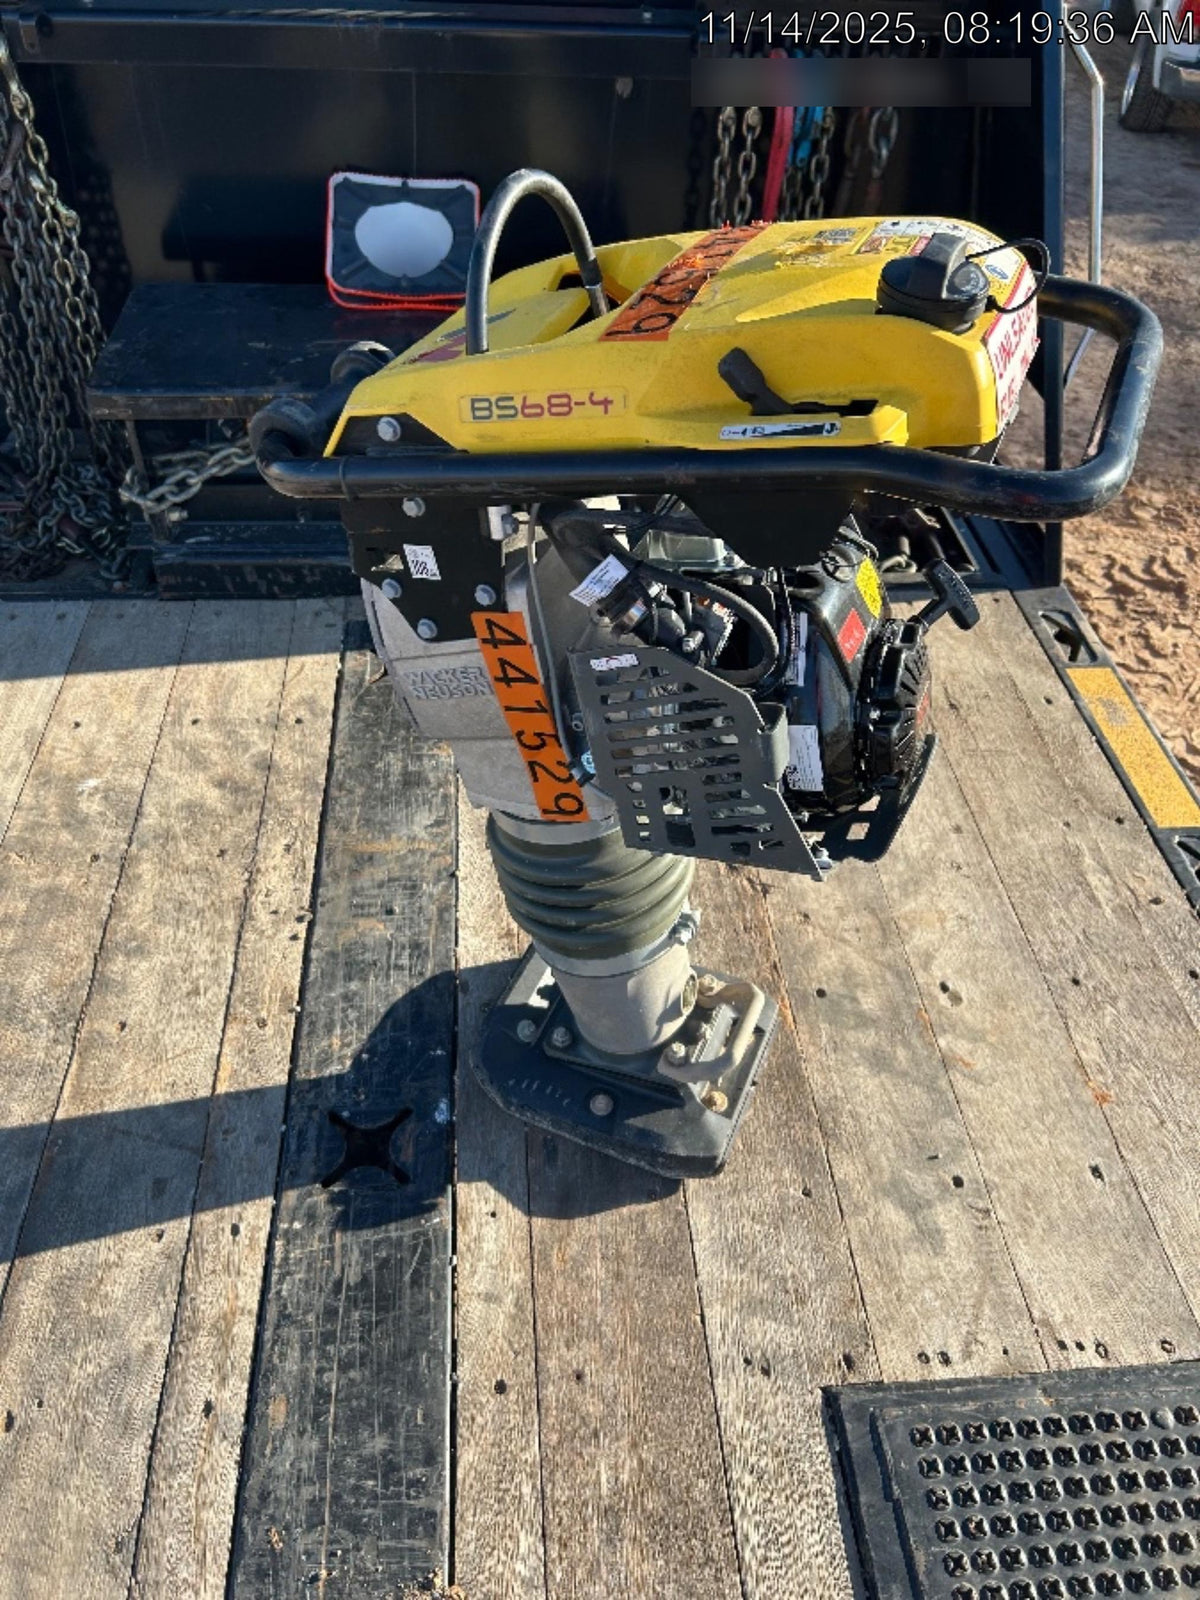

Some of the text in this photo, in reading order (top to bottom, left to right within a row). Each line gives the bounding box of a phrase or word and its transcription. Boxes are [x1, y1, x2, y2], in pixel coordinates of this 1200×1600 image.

[469, 391, 614, 421] BS68-4
[403, 665, 488, 686] WACKER
[412, 680, 496, 700] NEUSON
[480, 617, 585, 816] 441529
